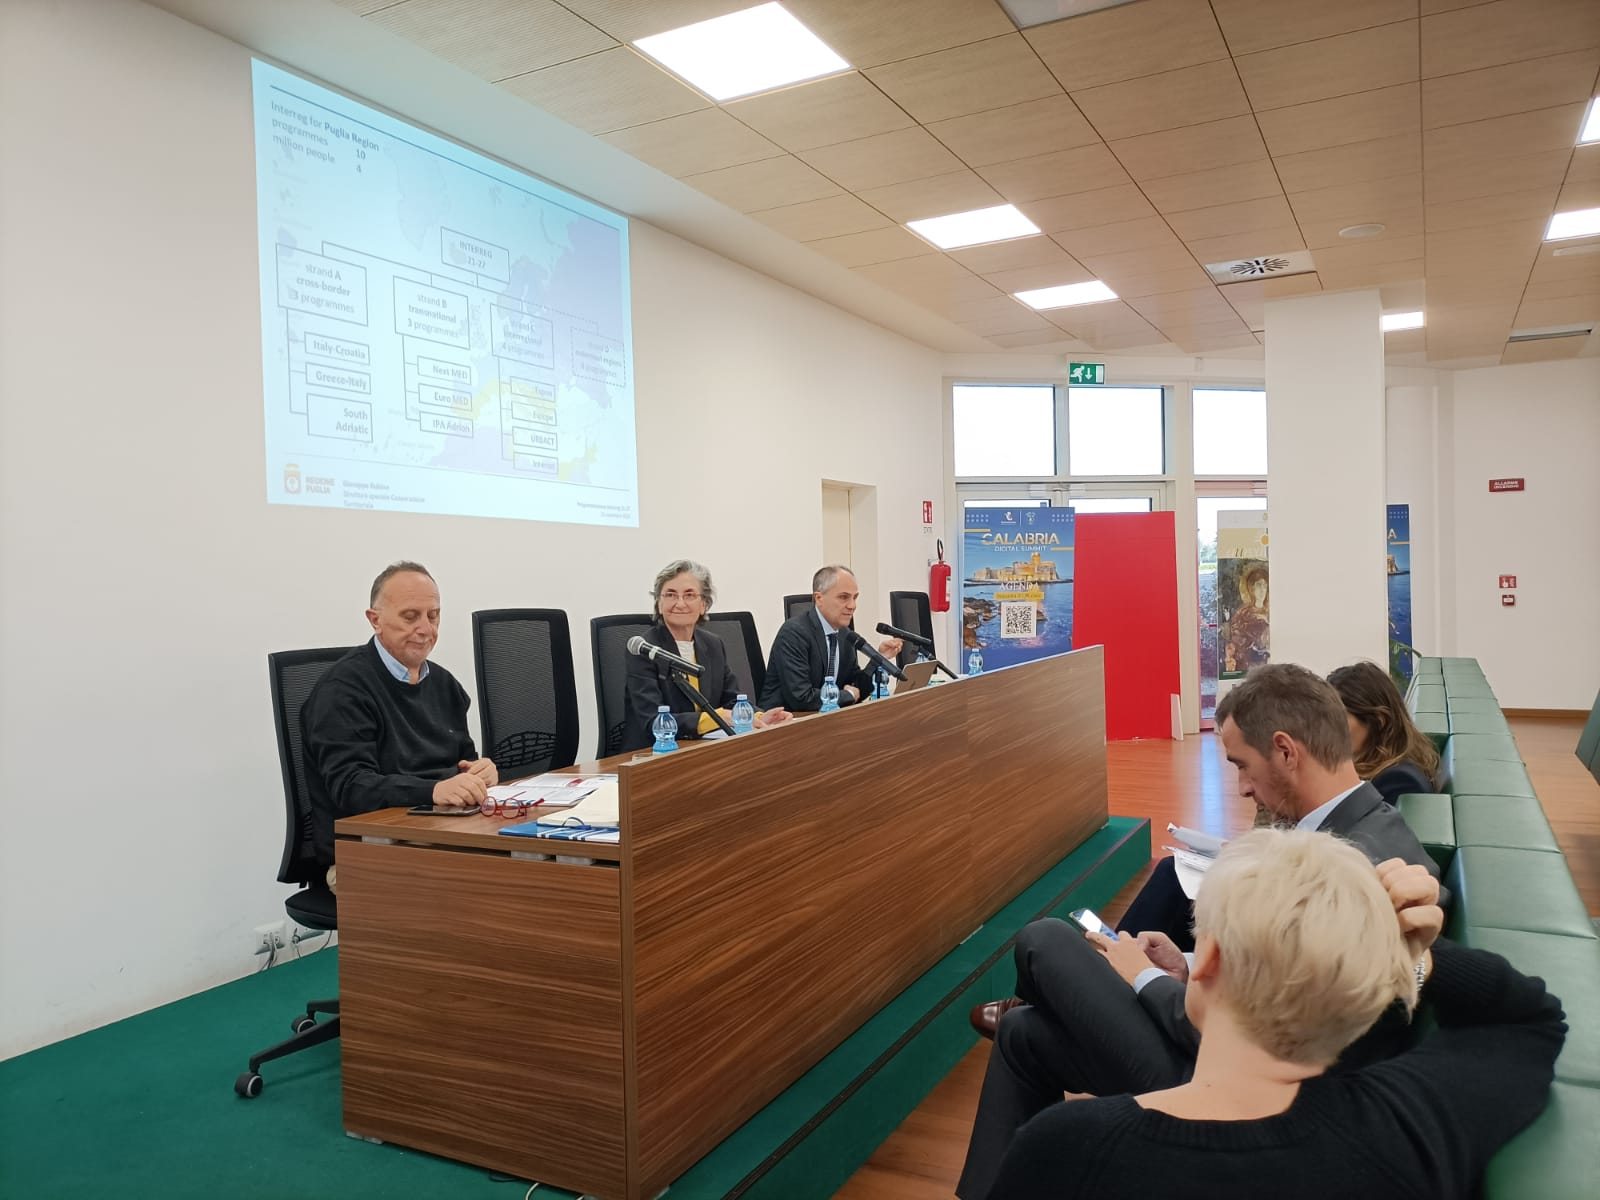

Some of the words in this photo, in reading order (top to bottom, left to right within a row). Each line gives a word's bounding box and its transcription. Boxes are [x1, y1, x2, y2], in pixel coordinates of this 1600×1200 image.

[271, 101, 308, 126] Interreg
[309, 117, 323, 129] for
[324, 121, 350, 140] Puglia
[352, 133, 380, 151] Region
[272, 118, 329, 147] programmes
[356, 149, 366, 160] 10
[273, 134, 304, 152] million
[306, 146, 336, 164] people
[356, 164, 362, 174] 4
[305, 264, 333, 279] strand
[334, 271, 342, 281] A
[296, 277, 351, 297] cross-border
[301, 293, 355, 314] programmes
[432, 364, 450, 377] Next
[434, 392, 451, 403] Euro
[343, 407, 368, 420] South
[336, 421, 369, 435] Adriatic
[982, 533, 1060, 545] CALABRIA
